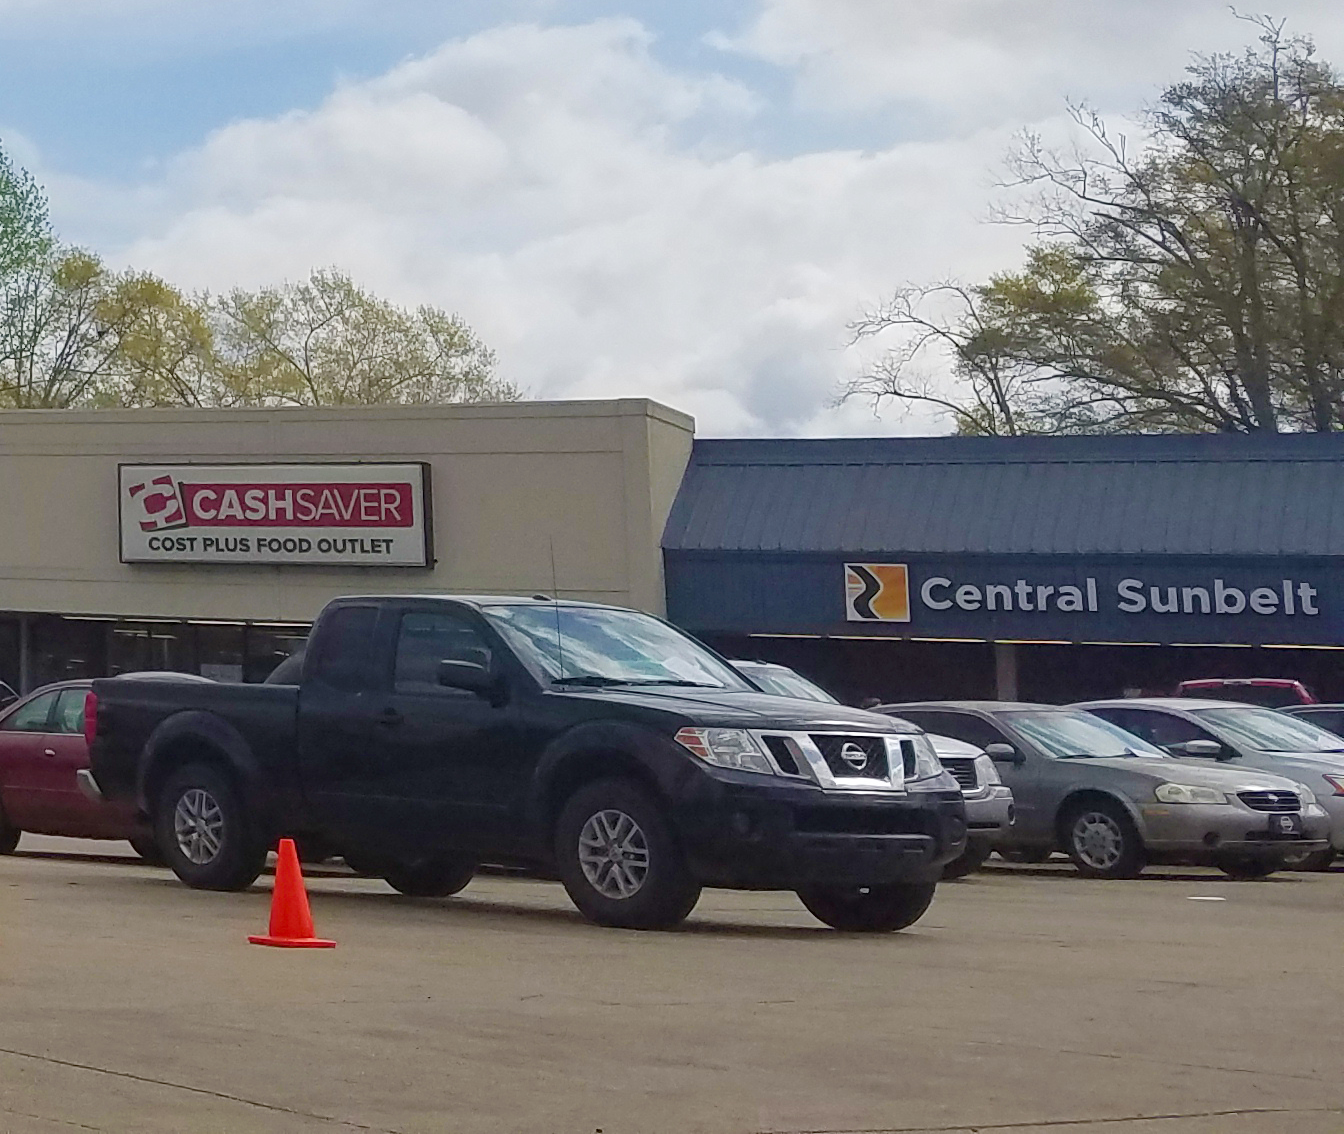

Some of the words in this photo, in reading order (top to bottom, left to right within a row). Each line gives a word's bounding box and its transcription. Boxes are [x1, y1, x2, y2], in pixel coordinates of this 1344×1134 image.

[148, 536, 198, 553] COST
[202, 537, 251, 554] PLUS
[256, 537, 311, 554] FOOD
[317, 538, 394, 555] OUTLET
[920, 577, 1098, 612] Central
[1116, 579, 1319, 615] Sunbelt
